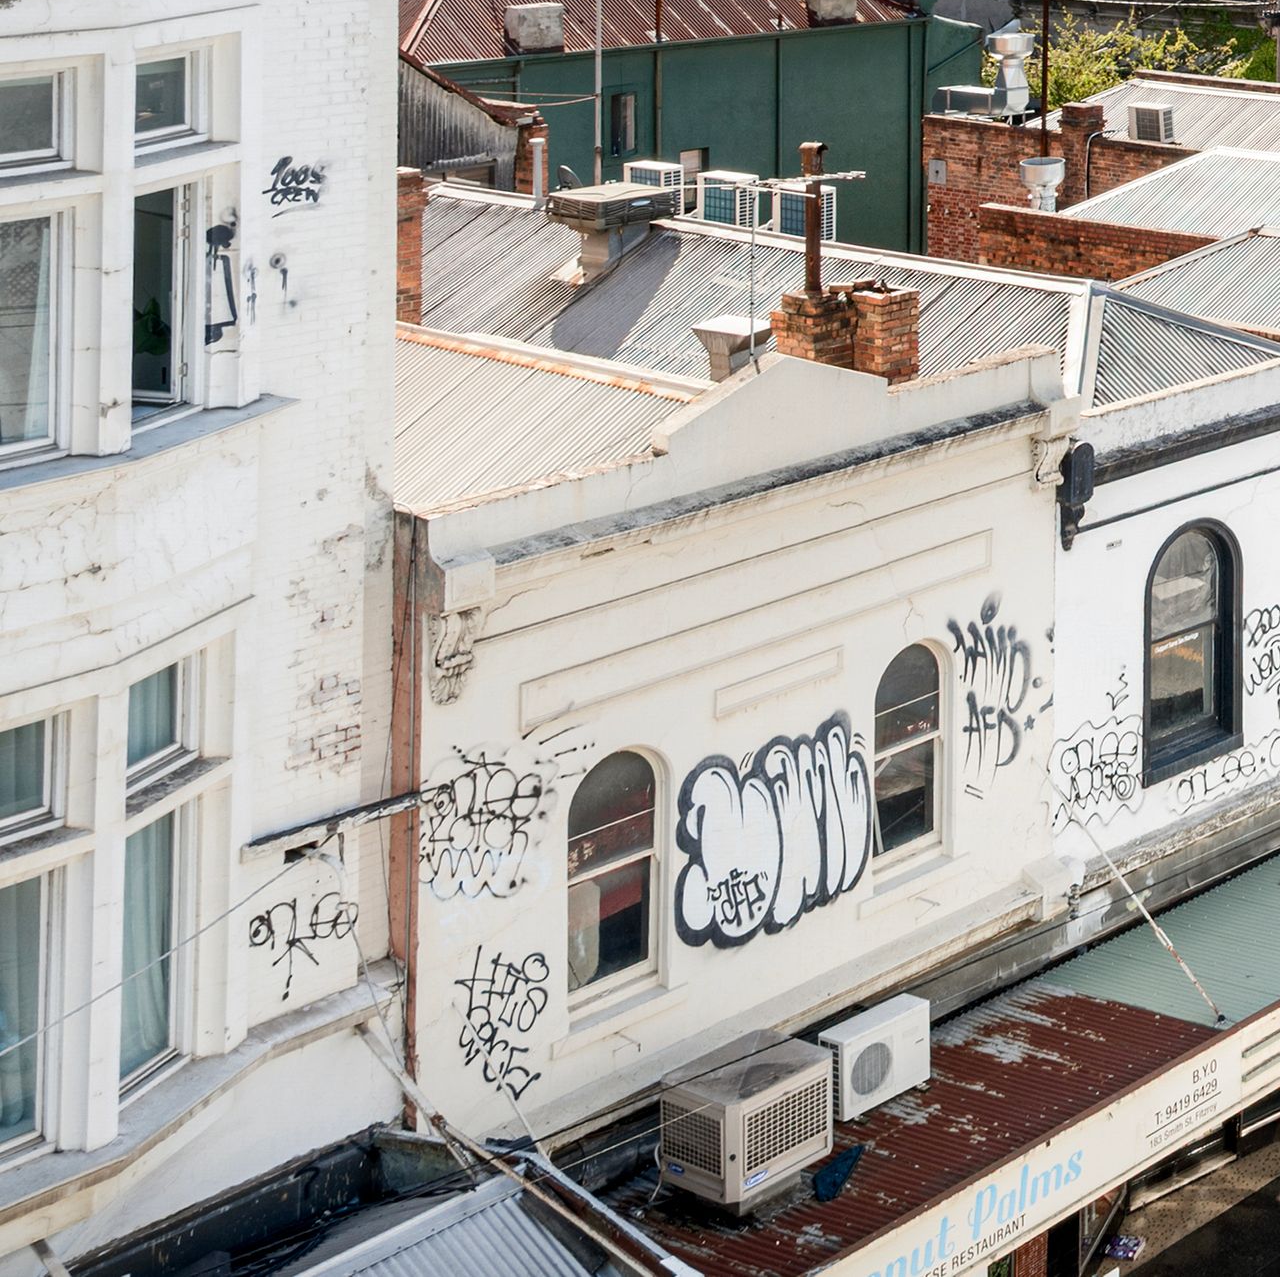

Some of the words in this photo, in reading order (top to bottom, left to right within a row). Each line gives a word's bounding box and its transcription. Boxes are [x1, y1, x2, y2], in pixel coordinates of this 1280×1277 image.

[1192, 1059, 1218, 1084] B.Y.O
[1154, 1111, 1164, 1126] T:
[1165, 1095, 1191, 1120] 9419
[1192, 1078, 1219, 1104] 6429
[1163, 1121, 1184, 1141] Smith
[1195, 1102, 1218, 1122] Fitzroy
[867, 1216, 957, 1277] nut
[966, 1149, 1085, 1242] Palms
[951, 1214, 1027, 1272] RESTAURANT
